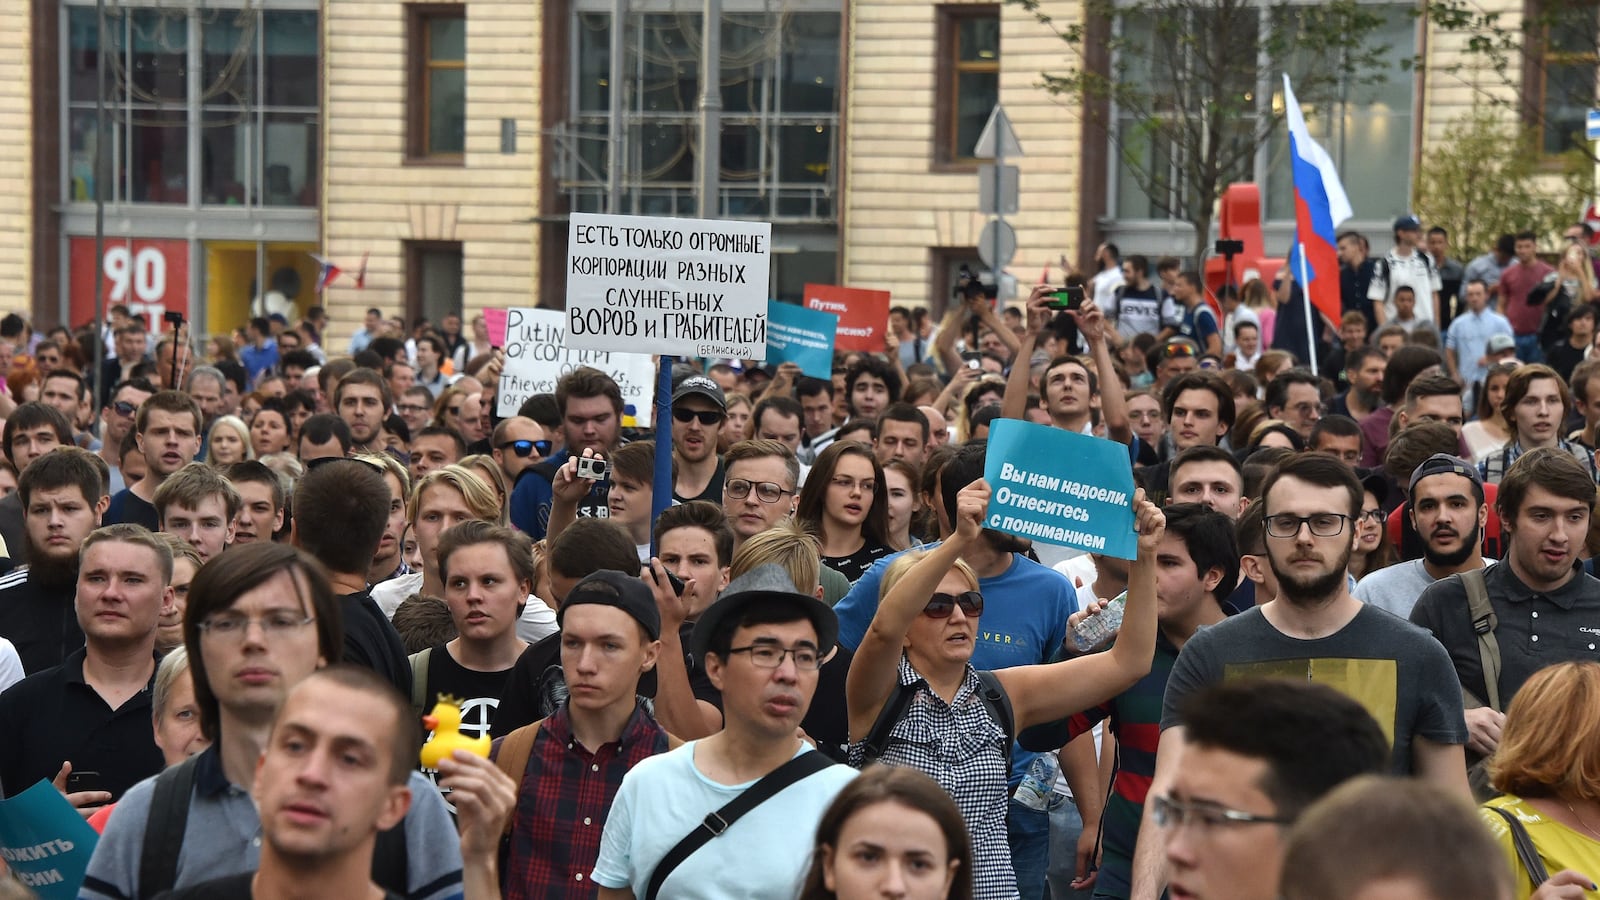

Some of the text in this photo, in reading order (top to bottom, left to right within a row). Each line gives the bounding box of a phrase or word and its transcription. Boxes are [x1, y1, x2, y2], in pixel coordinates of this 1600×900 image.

[576, 225, 764, 254] ЕСТЬ ТОЛЬКО ОГРОМНЫЕ
[102, 246, 167, 303] 90
[572, 256, 746, 284] КОРПОРАЦИИ РАЗНЫХ
[809, 298, 848, 312] Путин,
[570, 307, 638, 336] ВОРОВ
[663, 313, 766, 344] ГРАБИТЕЛЕЙ
[1000, 463, 1128, 507] Вы нам надоели.
[996, 487, 1090, 522] Отнеситесь
[990, 514, 1106, 550] с пониманием
[976, 632, 1012, 644] VER
[0, 839, 74, 862] ожить
